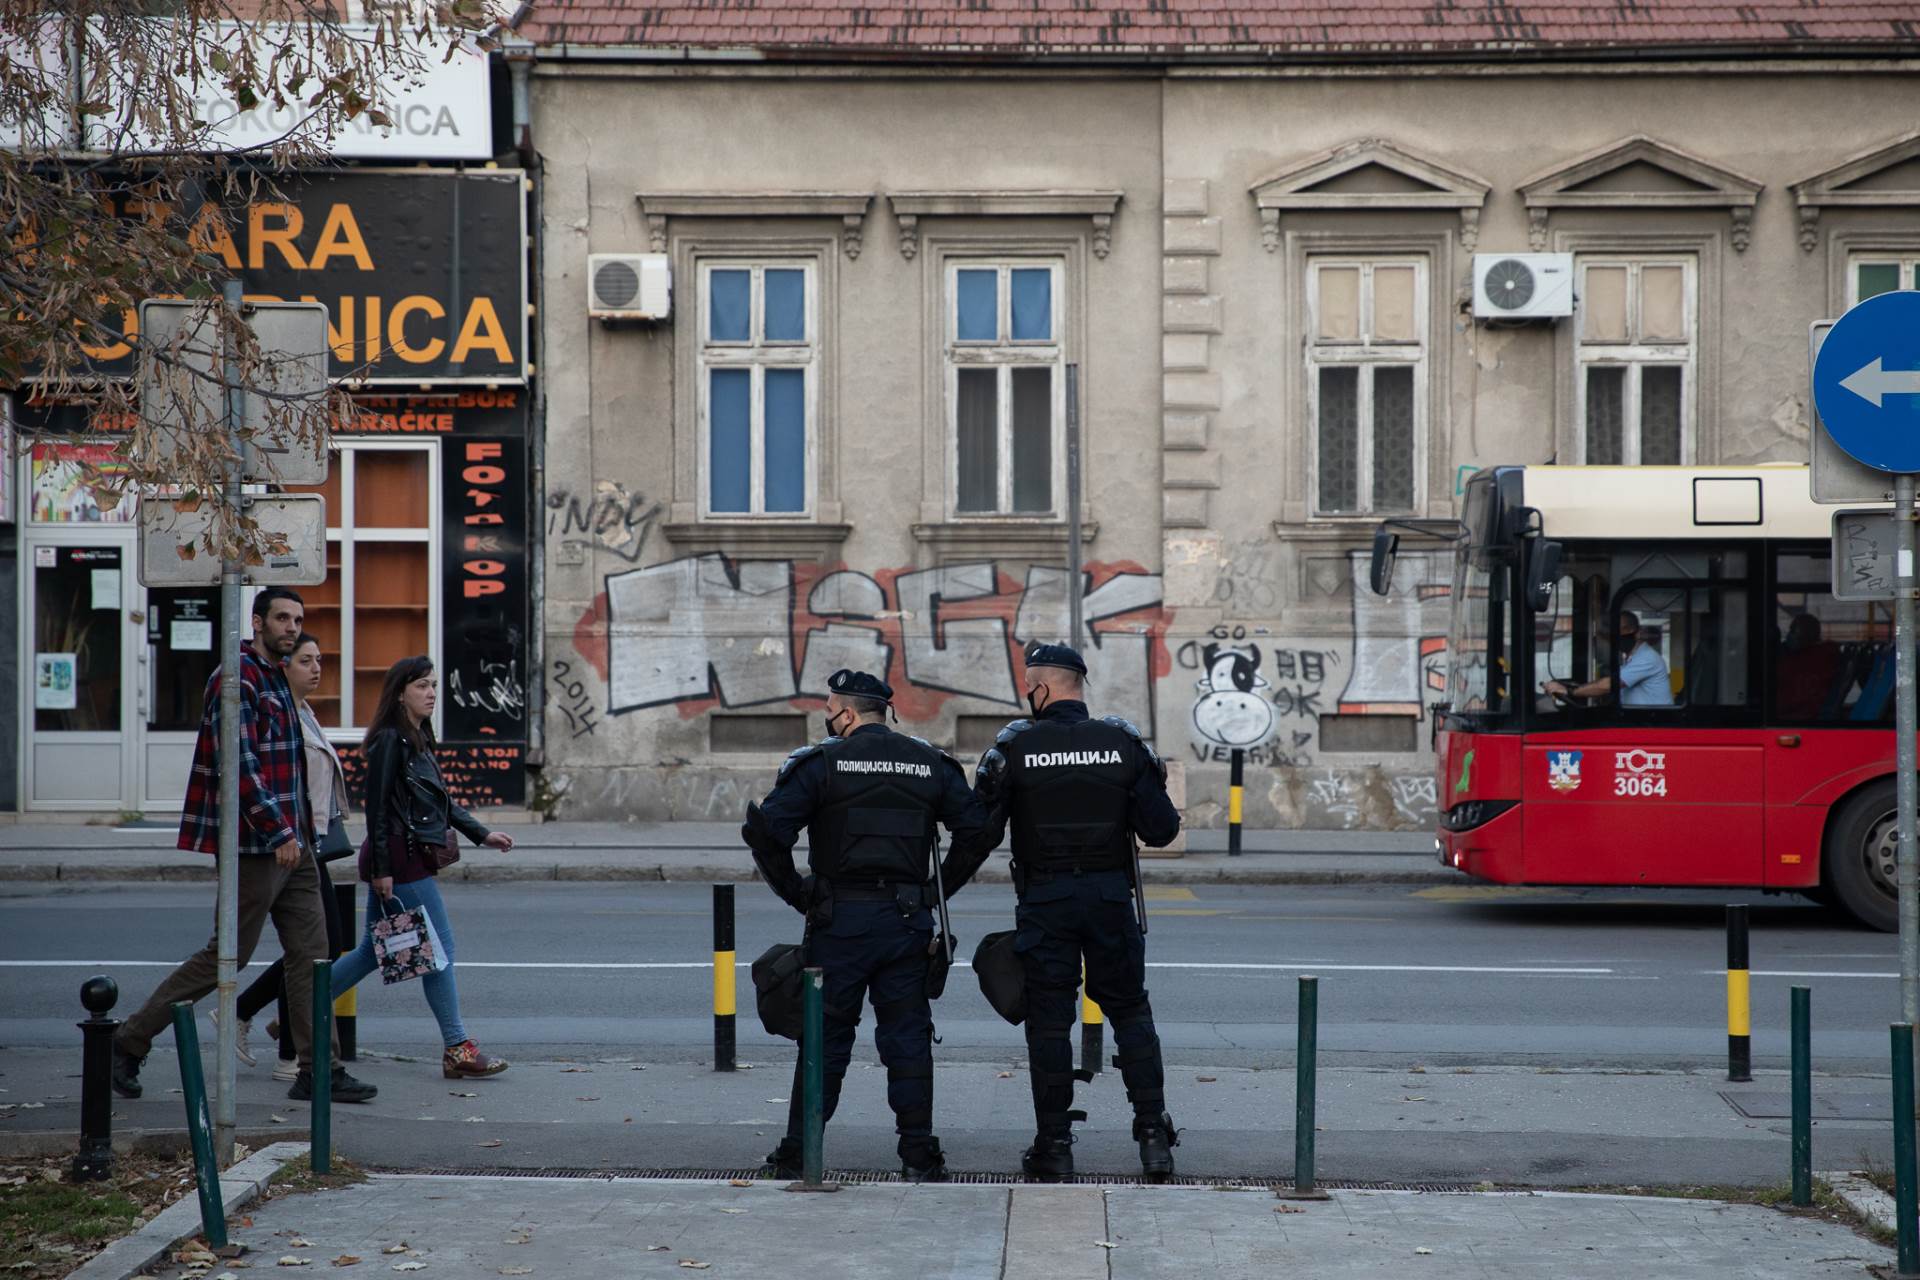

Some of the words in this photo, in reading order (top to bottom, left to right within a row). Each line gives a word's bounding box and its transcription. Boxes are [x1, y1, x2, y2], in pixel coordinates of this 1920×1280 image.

[552, 660, 598, 739] 2014
[836, 760, 894, 773] ПОЛИЦИЈСКА
[895, 763, 931, 777] БРИГАДА
[1024, 750, 1122, 768] ПОЛИЦИЈА
[1614, 777, 1667, 797] 3064
